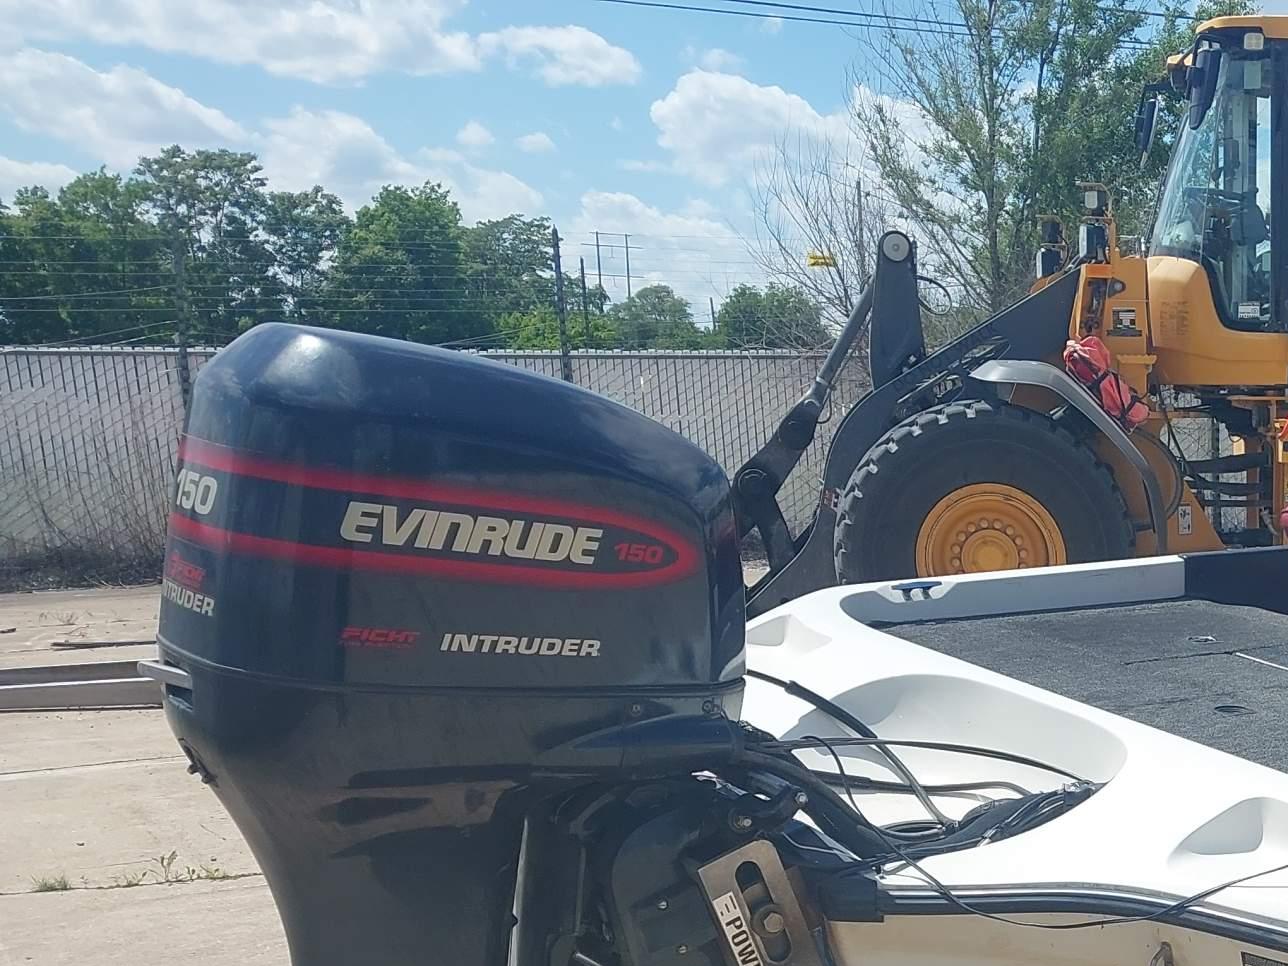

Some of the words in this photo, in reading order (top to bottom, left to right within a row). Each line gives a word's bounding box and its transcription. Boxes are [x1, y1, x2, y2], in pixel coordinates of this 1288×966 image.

[176, 468, 217, 515] 150
[340, 501, 603, 565] EVINRUDE
[614, 543, 662, 564] 150
[162, 578, 215, 616] NTRUDER
[440, 633, 600, 657] INTRUDER
